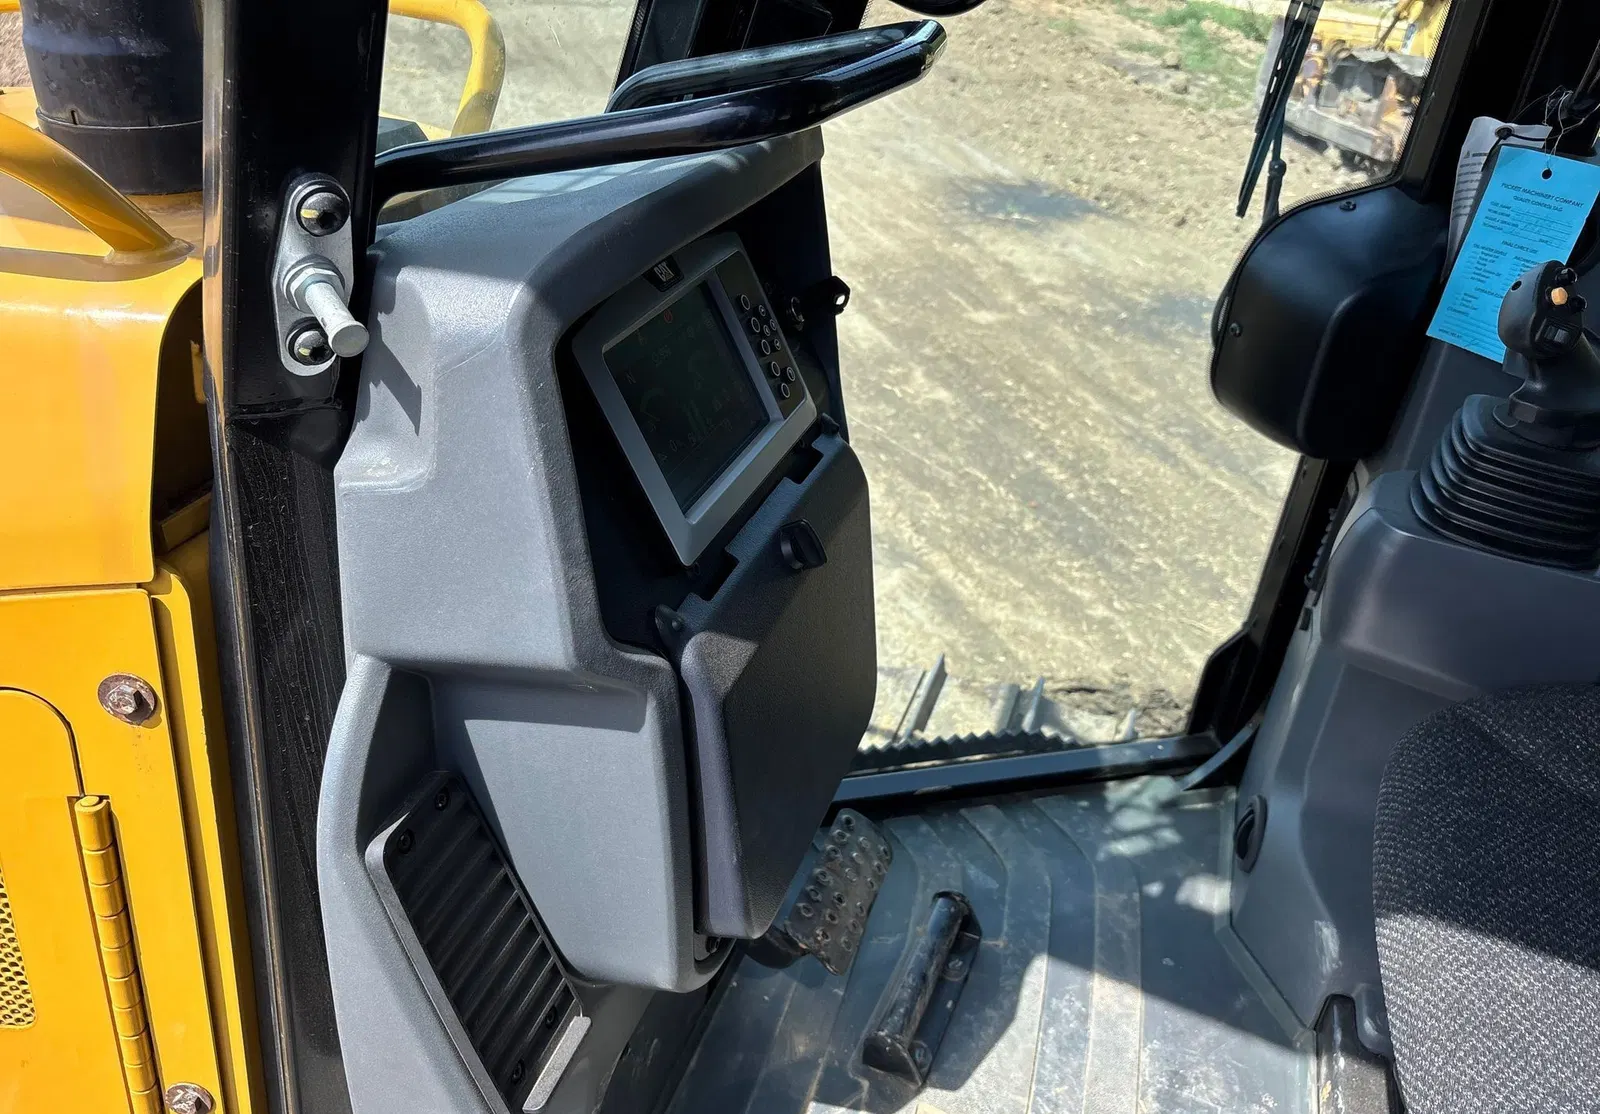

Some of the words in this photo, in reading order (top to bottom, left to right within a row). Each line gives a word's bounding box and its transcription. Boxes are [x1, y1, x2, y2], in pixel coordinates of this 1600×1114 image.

[1521, 187, 1555, 200] MACHINERY
[1554, 196, 1585, 208] COMPANY
[653, 261, 675, 282] CAT
